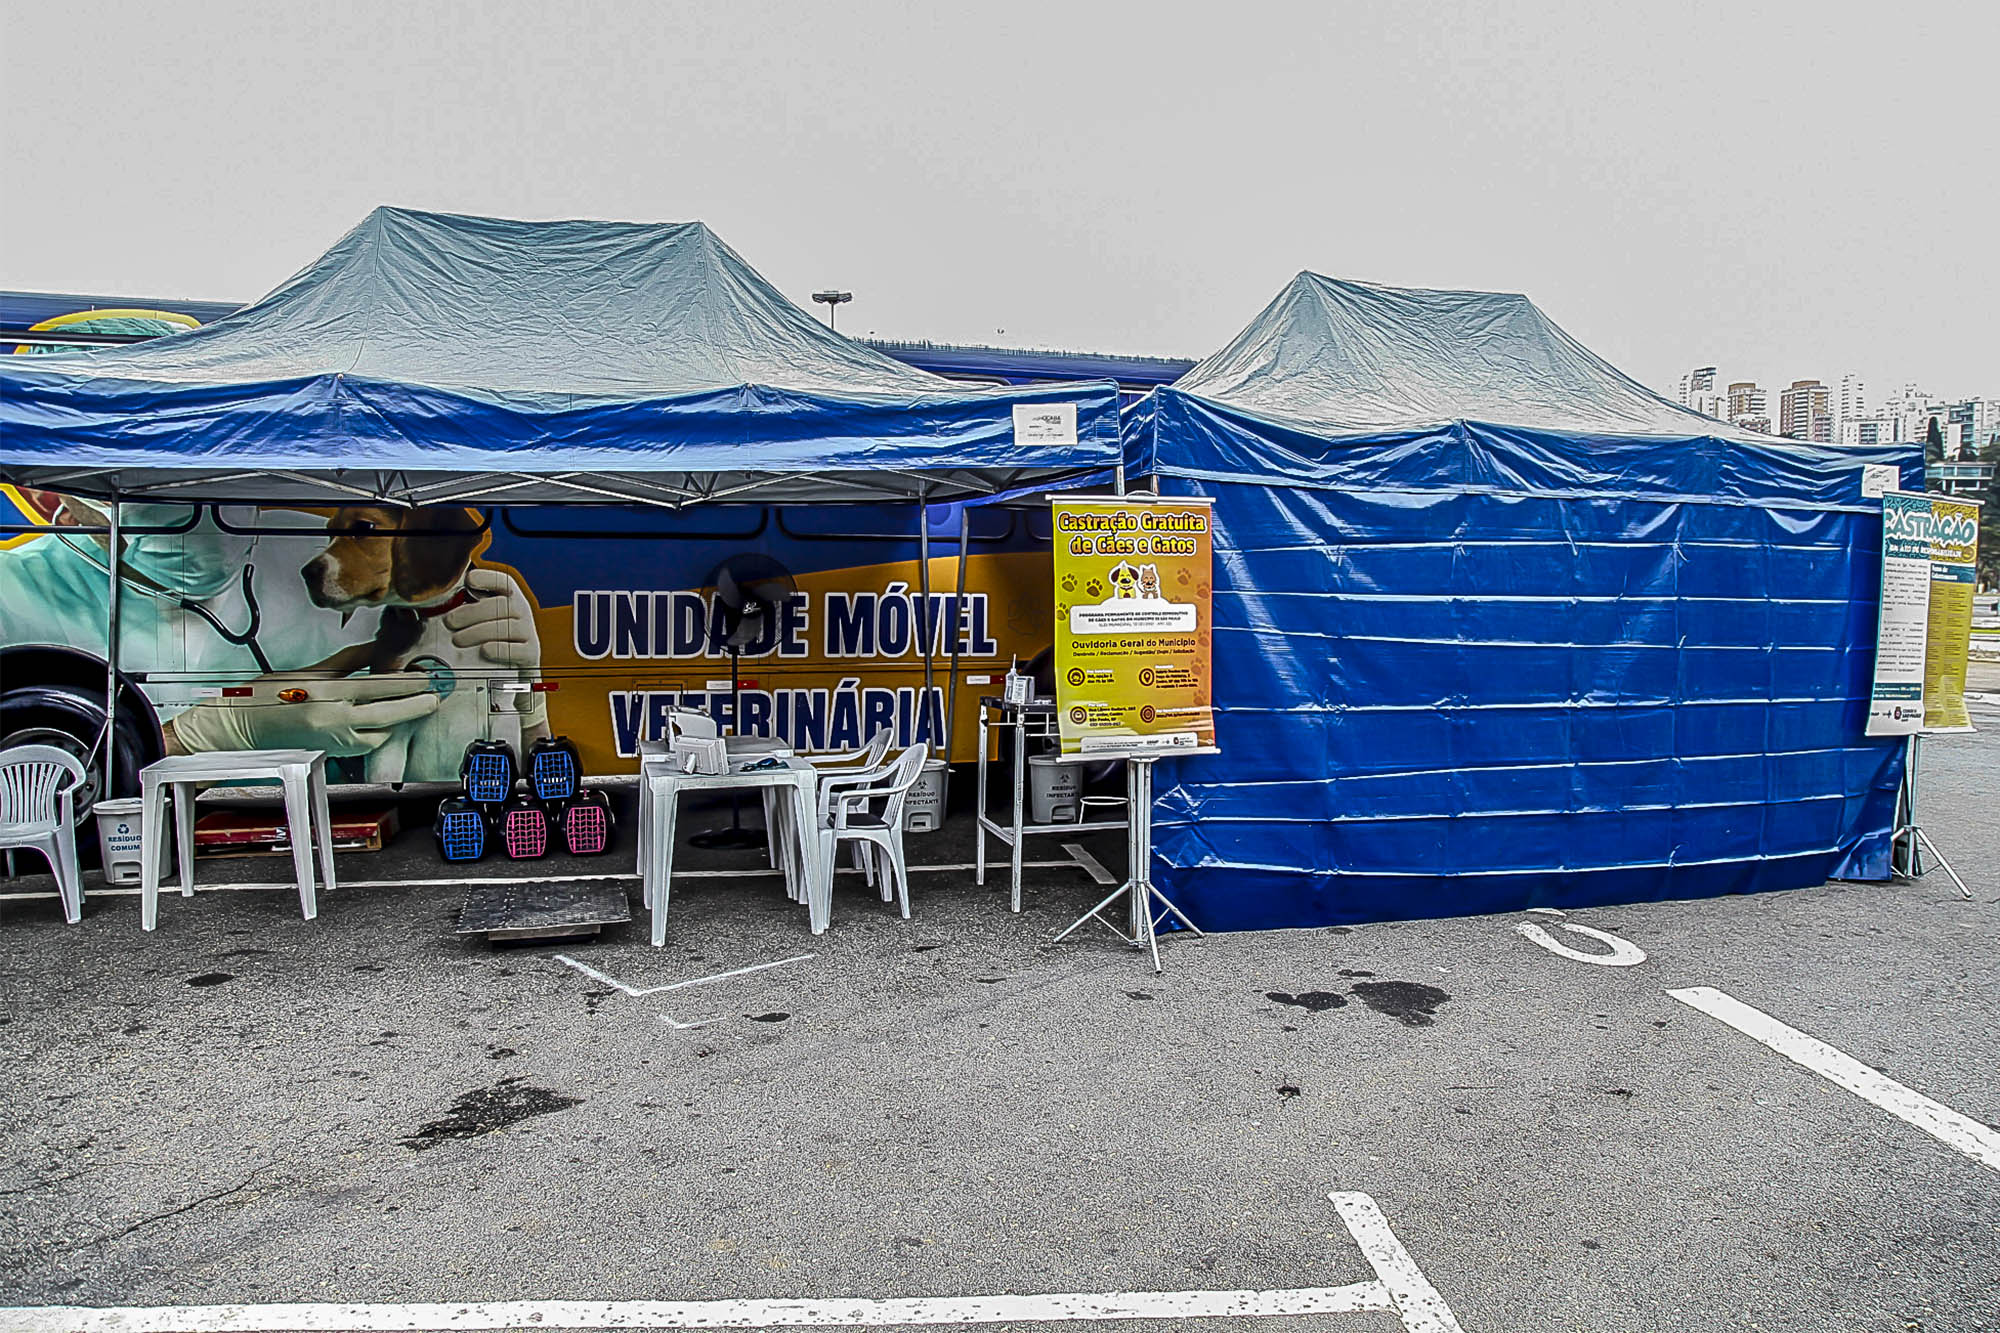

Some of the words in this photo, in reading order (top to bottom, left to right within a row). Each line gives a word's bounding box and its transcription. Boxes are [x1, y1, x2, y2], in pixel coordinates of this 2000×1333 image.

[1058, 511, 1138, 535] Castração
[1141, 512, 1205, 531] Gratuita
[1071, 535, 1093, 554] de
[1096, 534, 1134, 554] Cães
[1138, 540, 1148, 554] e
[1151, 537, 1195, 554] Gatos
[574, 590, 809, 660] UNIDADE
[824, 581, 997, 658] MÓVEL
[1072, 640, 1118, 649] Ouvidoria
[1120, 639, 1144, 648] Geral
[1146, 639, 1157, 647] do
